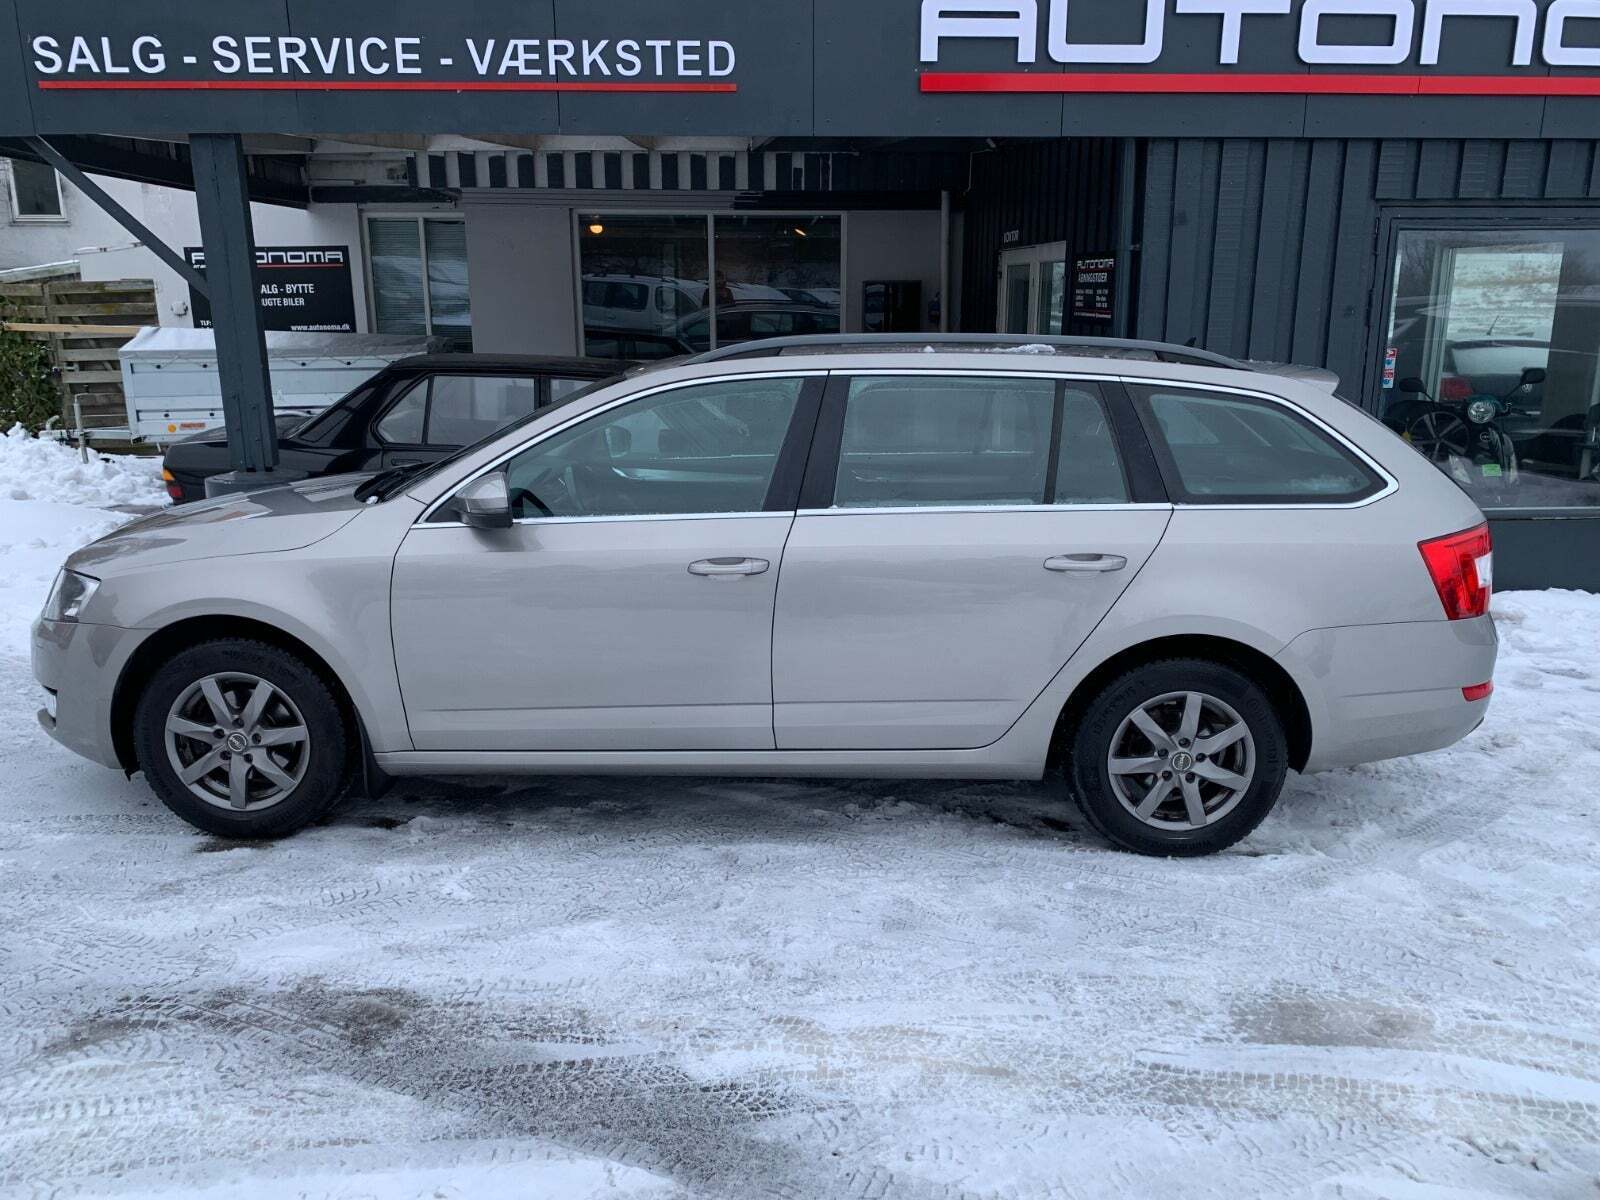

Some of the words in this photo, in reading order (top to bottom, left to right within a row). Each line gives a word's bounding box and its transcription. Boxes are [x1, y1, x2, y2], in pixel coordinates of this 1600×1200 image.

[33, 36, 166, 74] SALG
[212, 36, 422, 75] SERVICE
[466, 39, 736, 76] VÆRKSTED
[260, 284, 279, 295] ALG
[285, 283, 315, 294] BYTTE
[261, 298, 282, 307] UGTE
[282, 297, 305, 307] BILER
